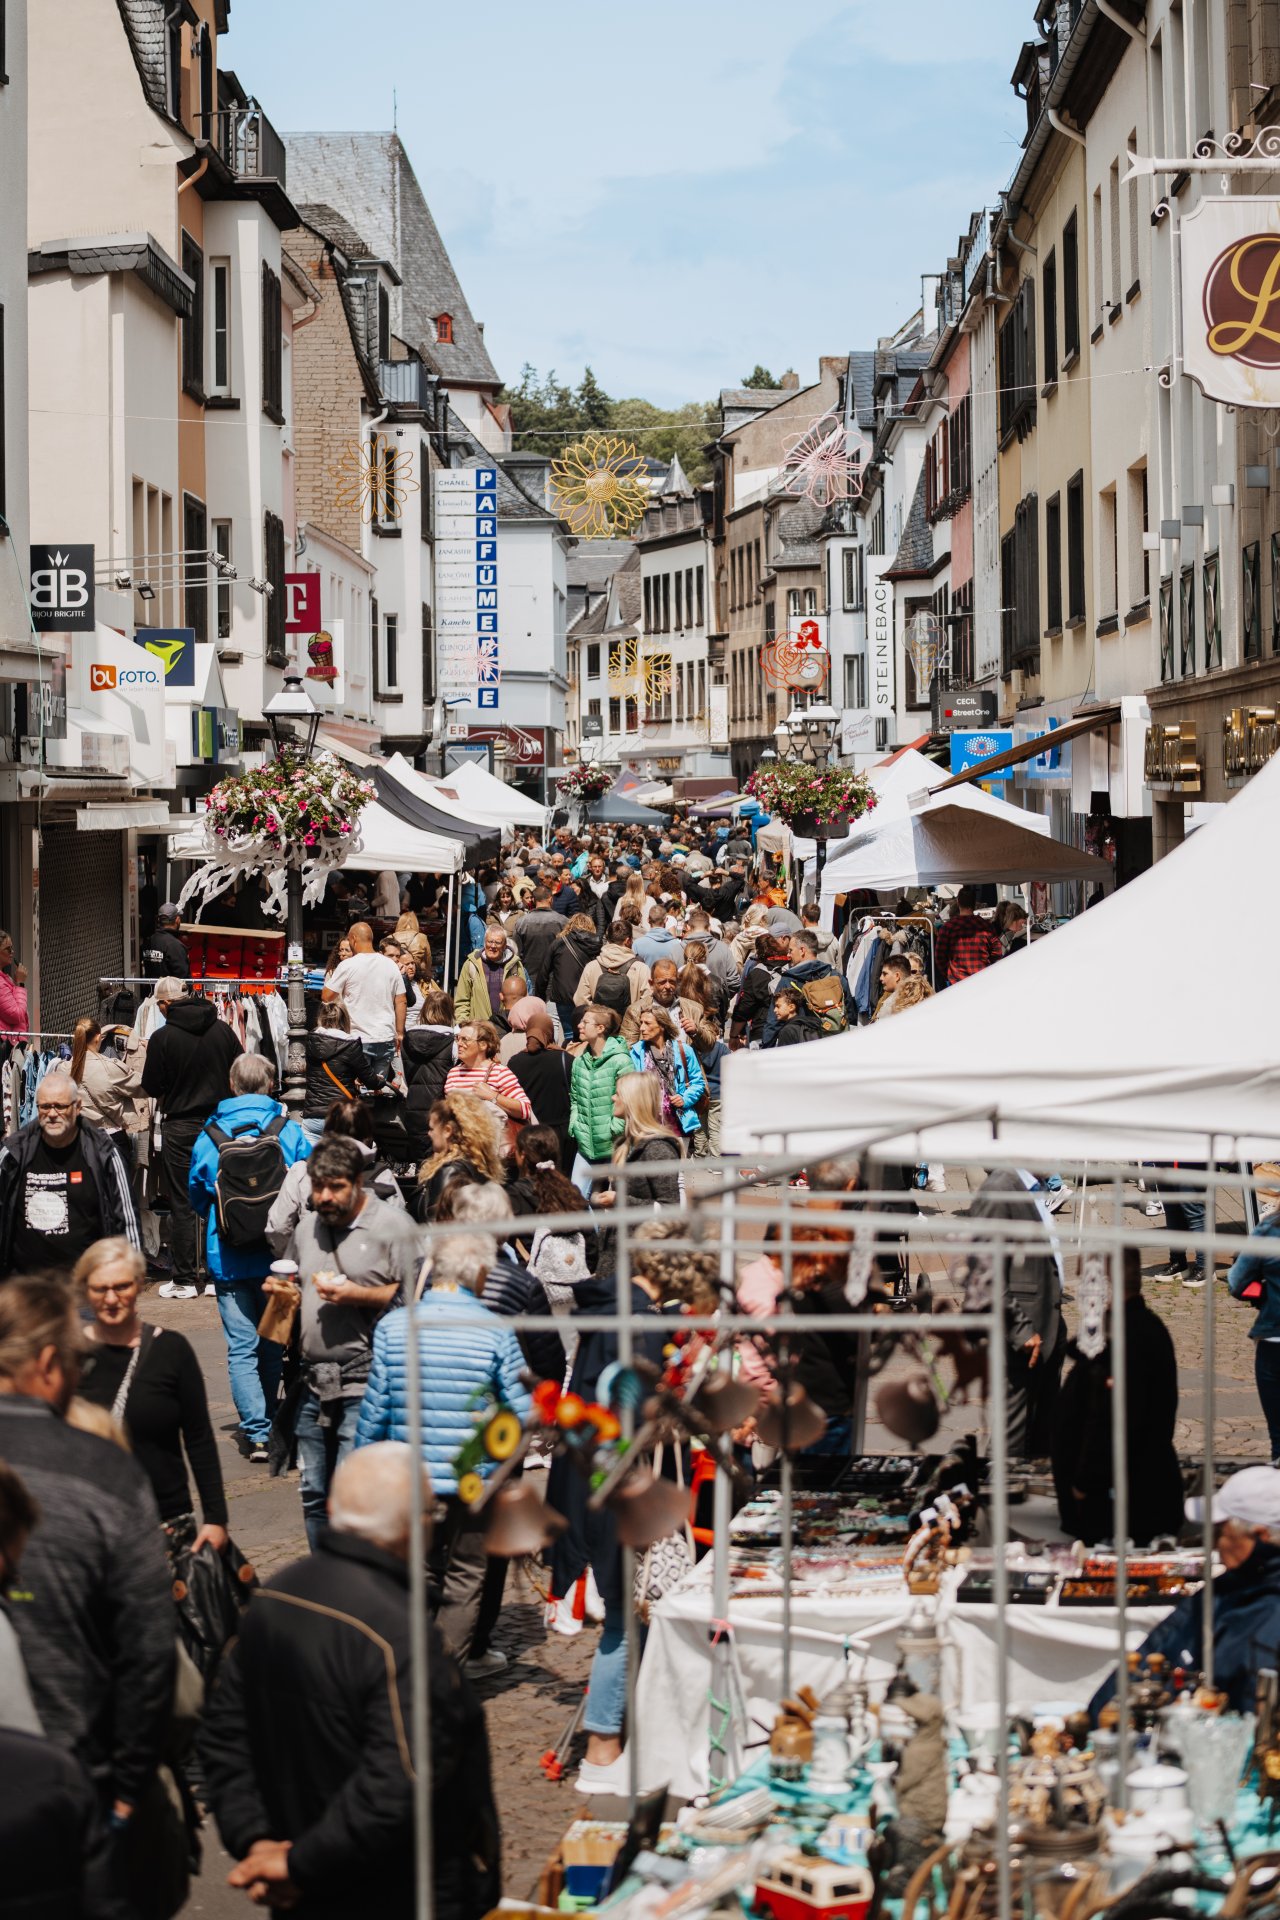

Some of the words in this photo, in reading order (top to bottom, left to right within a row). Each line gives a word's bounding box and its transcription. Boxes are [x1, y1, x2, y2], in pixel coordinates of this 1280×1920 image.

[31, 610, 52, 618] BIJOU
[54, 610, 86, 618] BRIGITTE
[441, 618, 471, 626] Kanebo
[439, 643, 472, 652] CLINIQUE
[450, 726, 466, 735] ER
